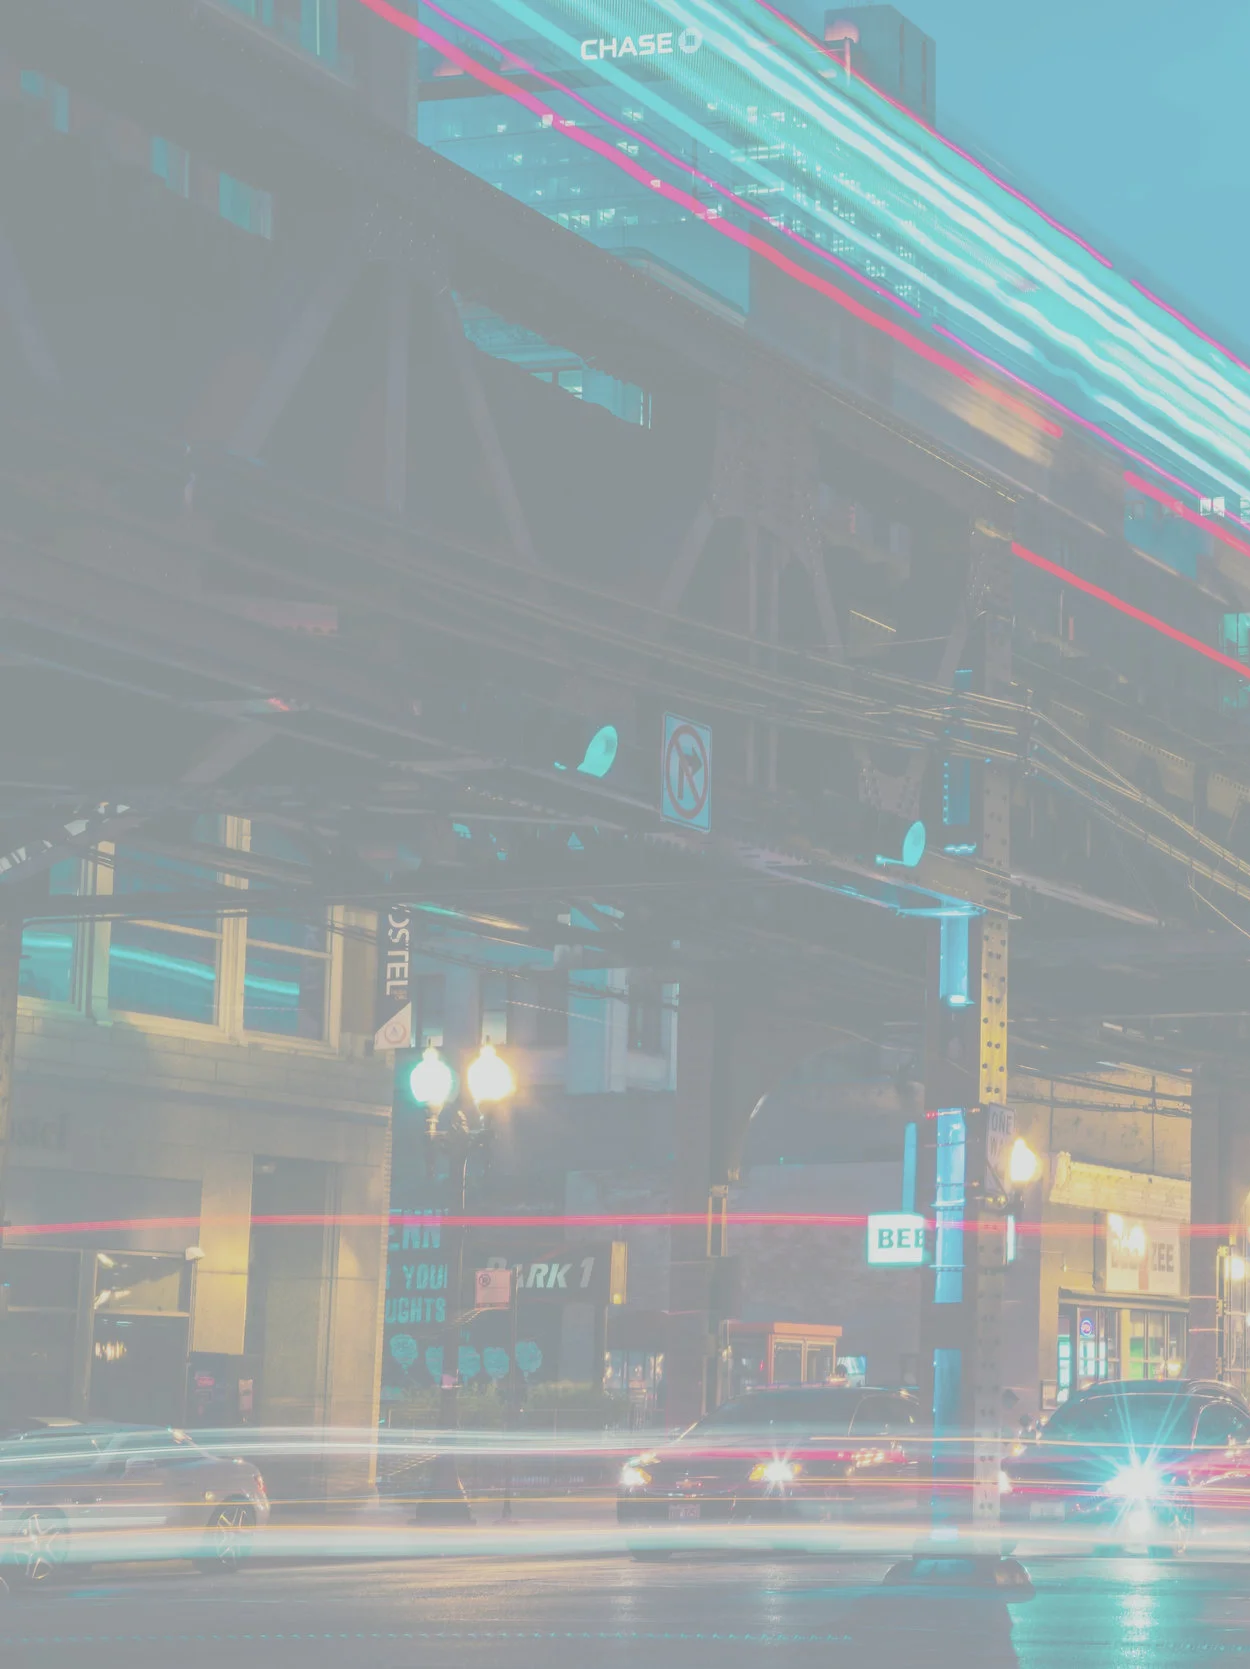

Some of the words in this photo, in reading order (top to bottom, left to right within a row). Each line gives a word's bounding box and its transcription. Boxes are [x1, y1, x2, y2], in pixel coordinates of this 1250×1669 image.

[580, 32, 673, 60] CHASE
[386, 904, 411, 996] OSTEL
[992, 1110, 1012, 1135] ONE
[878, 1228, 926, 1249] BEE
[402, 1263, 449, 1290] YOU
[580, 1257, 596, 1288] 1
[385, 1295, 447, 1324] UGHTS
